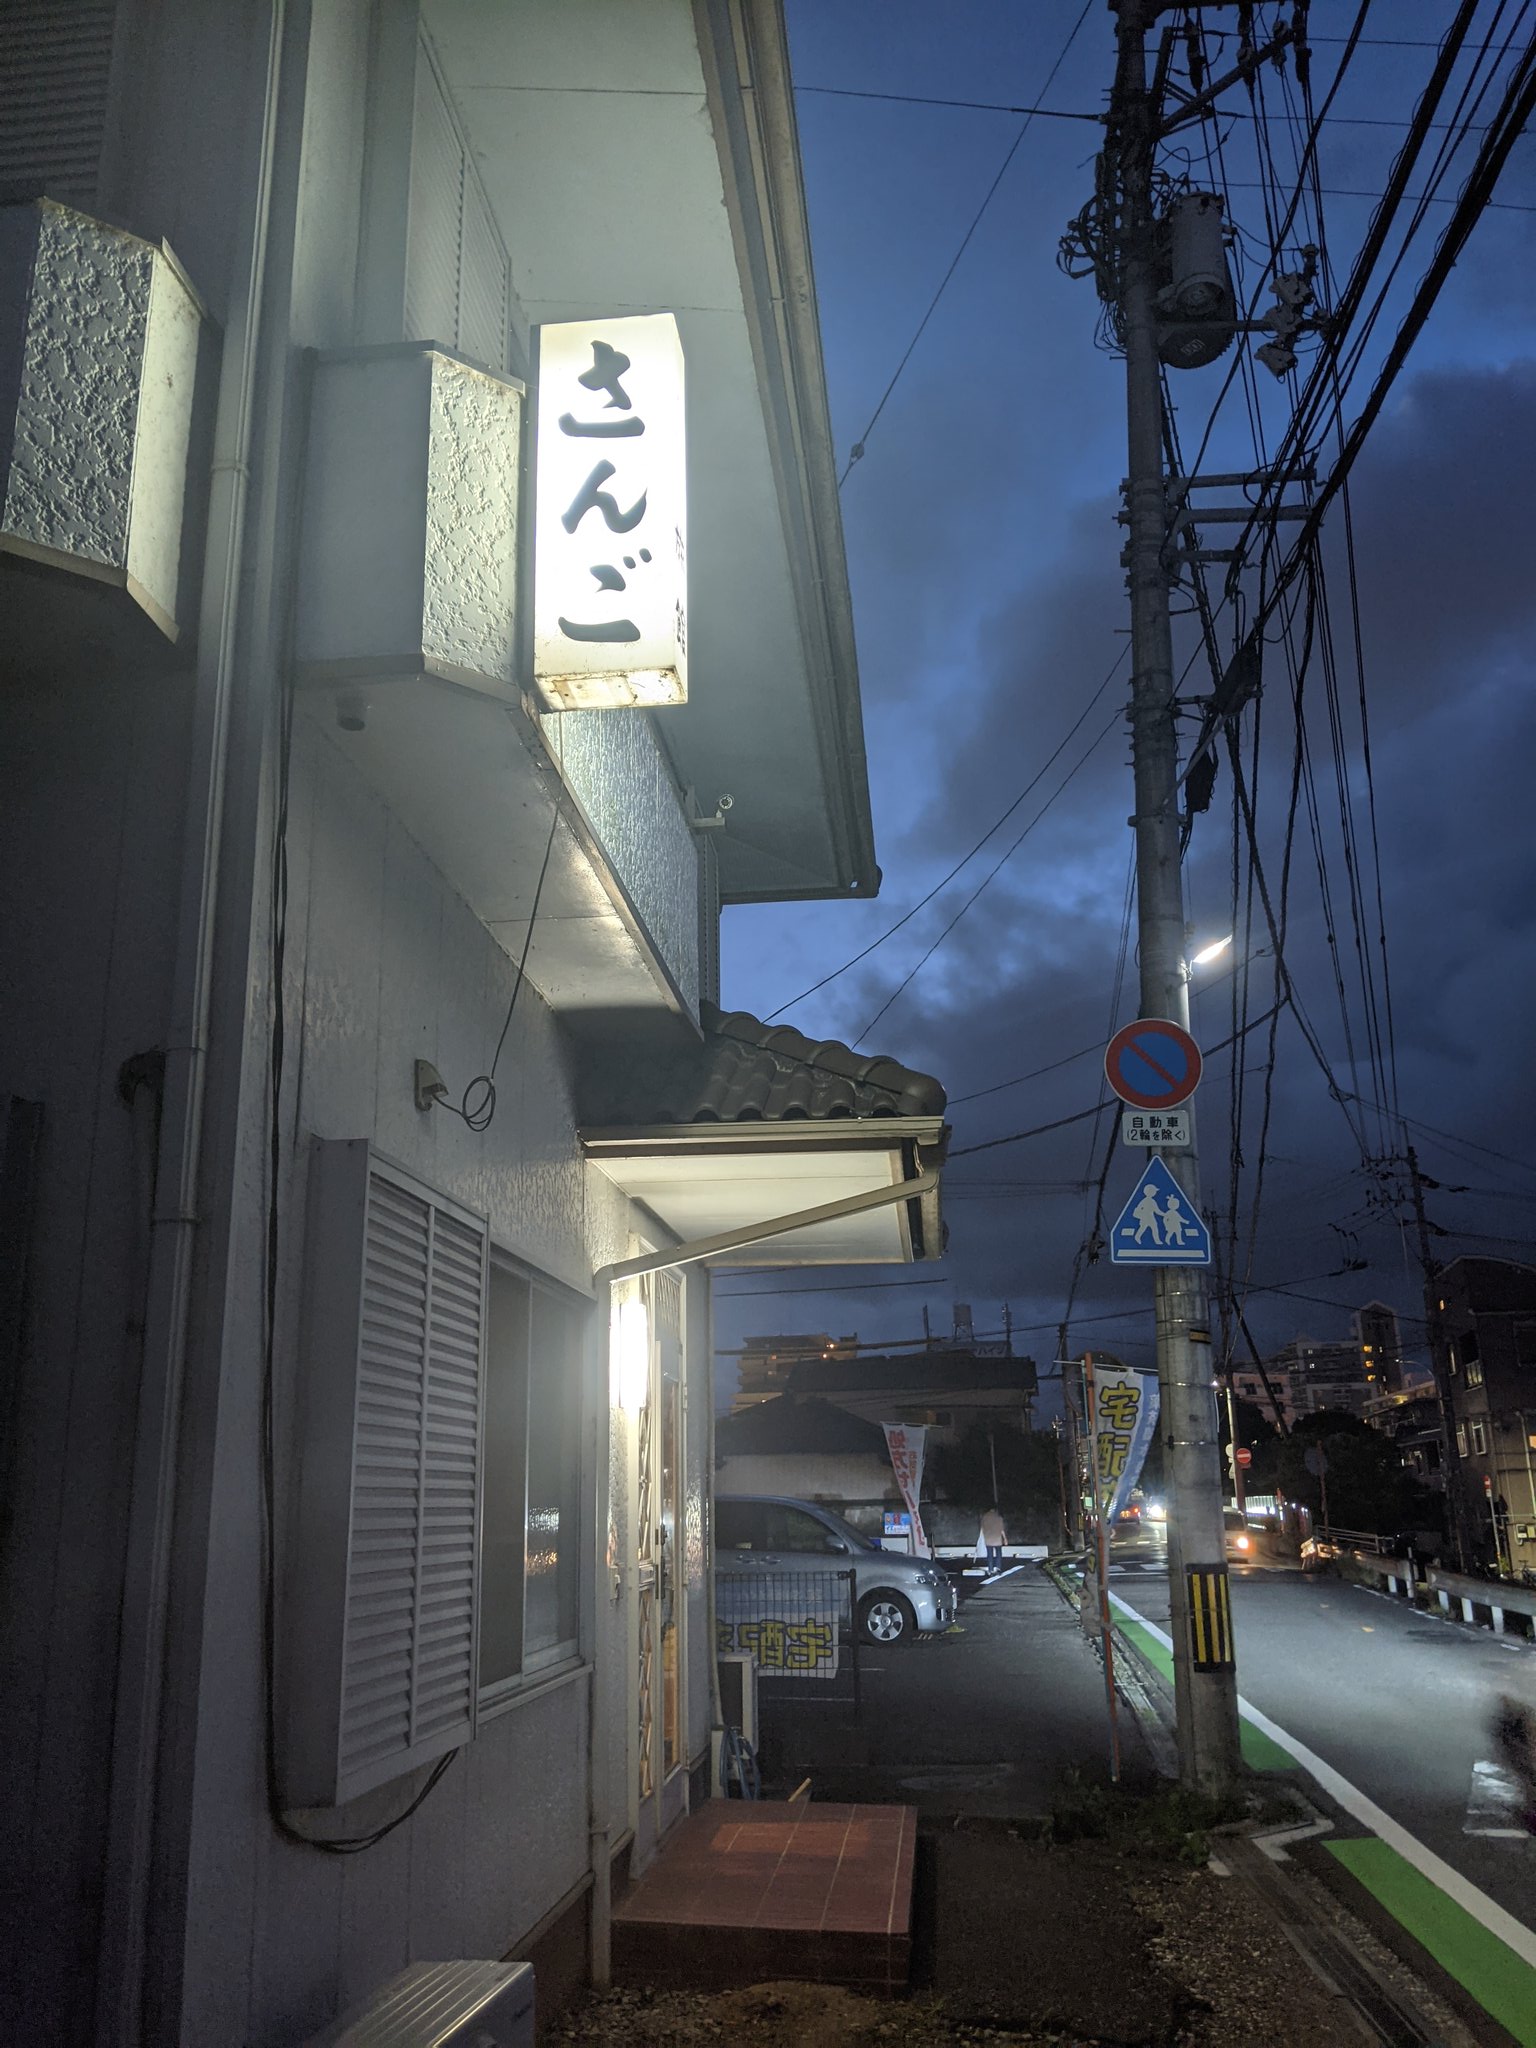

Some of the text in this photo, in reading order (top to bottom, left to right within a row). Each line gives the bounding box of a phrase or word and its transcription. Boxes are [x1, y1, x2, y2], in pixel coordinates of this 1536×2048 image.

[558, 340, 652, 643] さんご
[1132, 1116, 1179, 1129] 自動車
